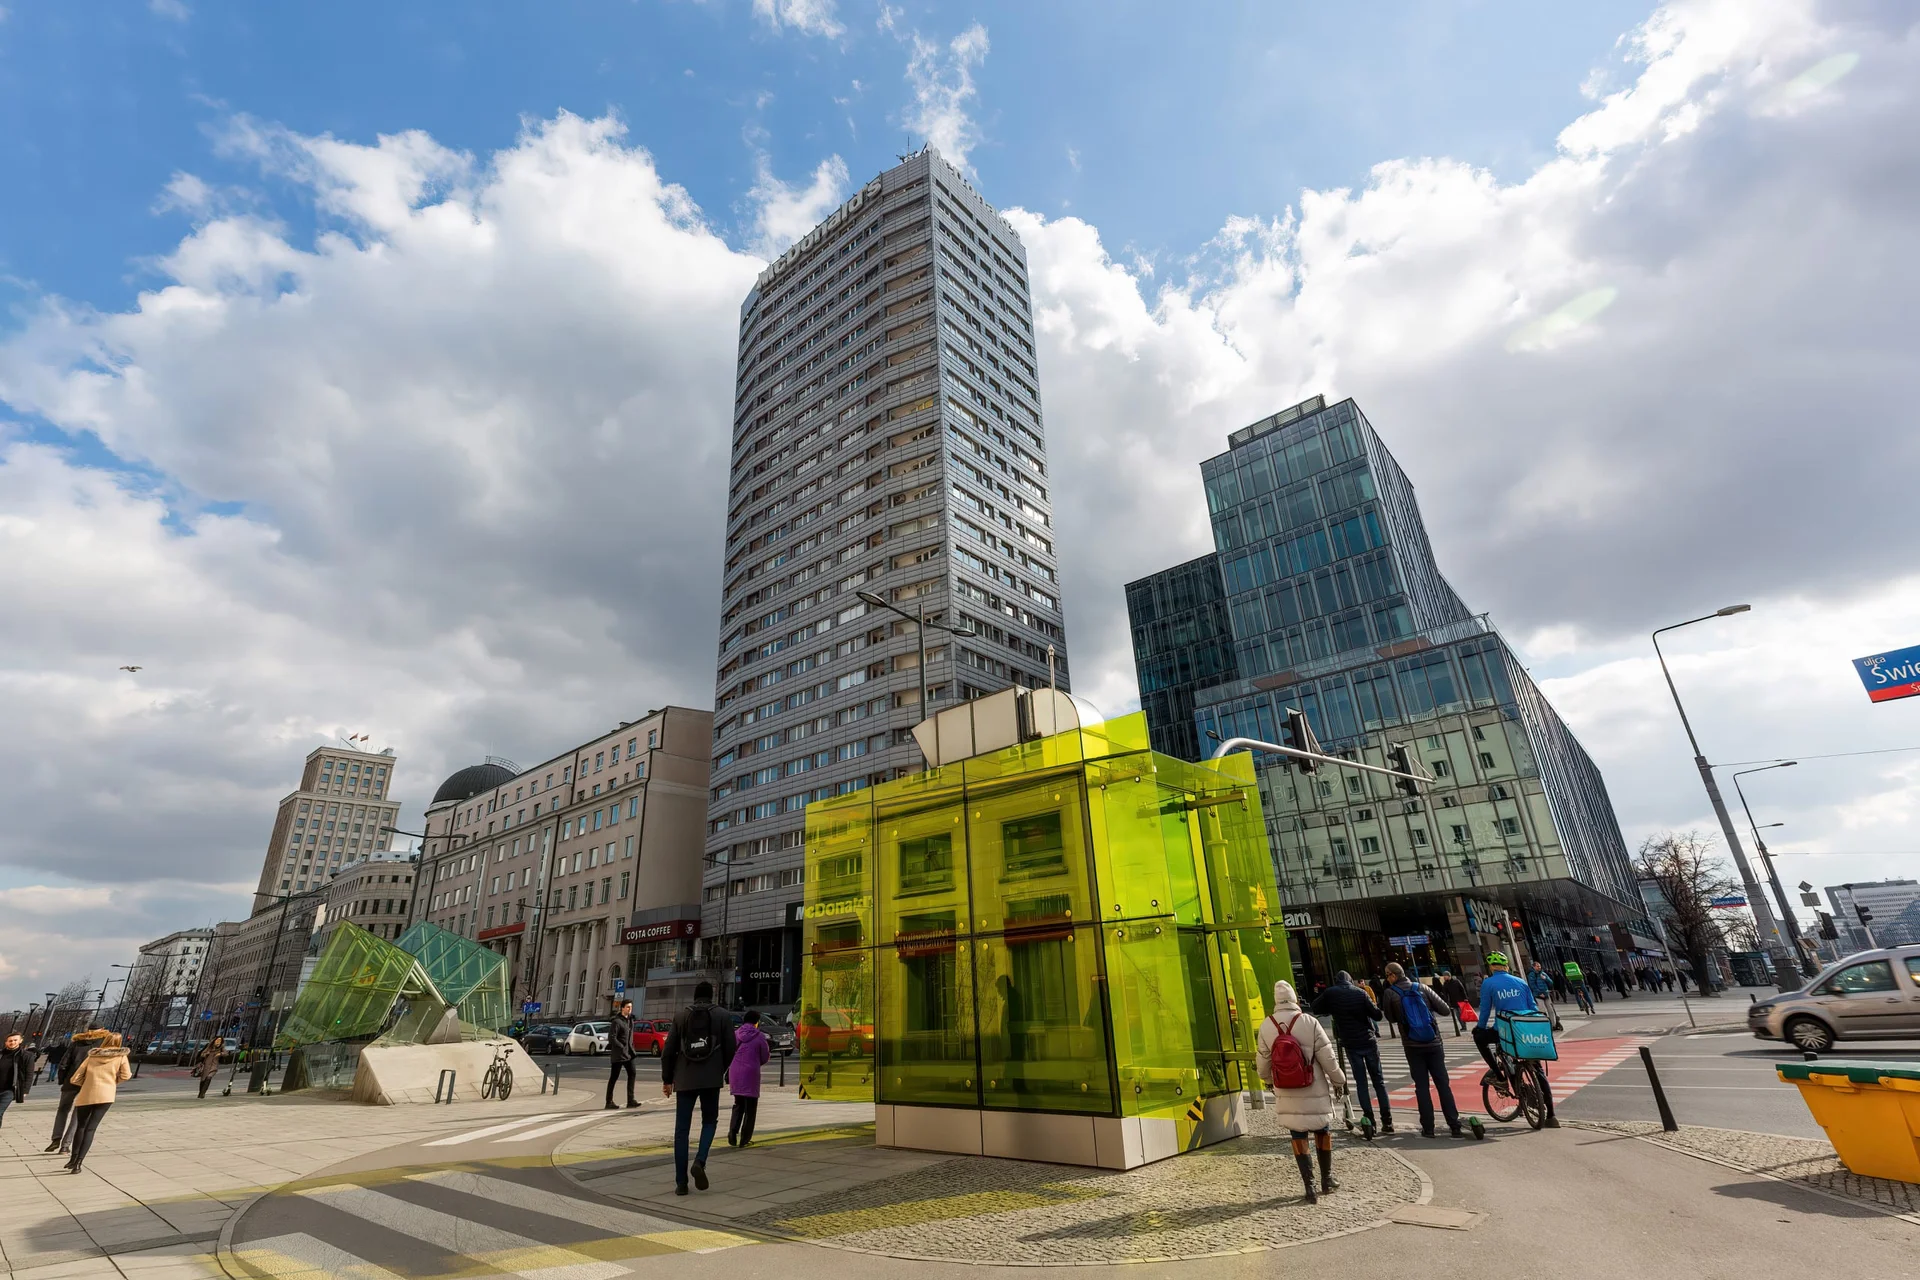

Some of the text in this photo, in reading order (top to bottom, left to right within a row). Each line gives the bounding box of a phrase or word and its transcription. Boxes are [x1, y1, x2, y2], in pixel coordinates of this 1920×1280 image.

[757, 178, 882, 292] McDonald's
[626, 925, 671, 940] COSTA COFFEE
[749, 972, 770, 980] COSTA
[1497, 988, 1521, 1000] Wolt
[1521, 1033, 1550, 1045] Wolt
